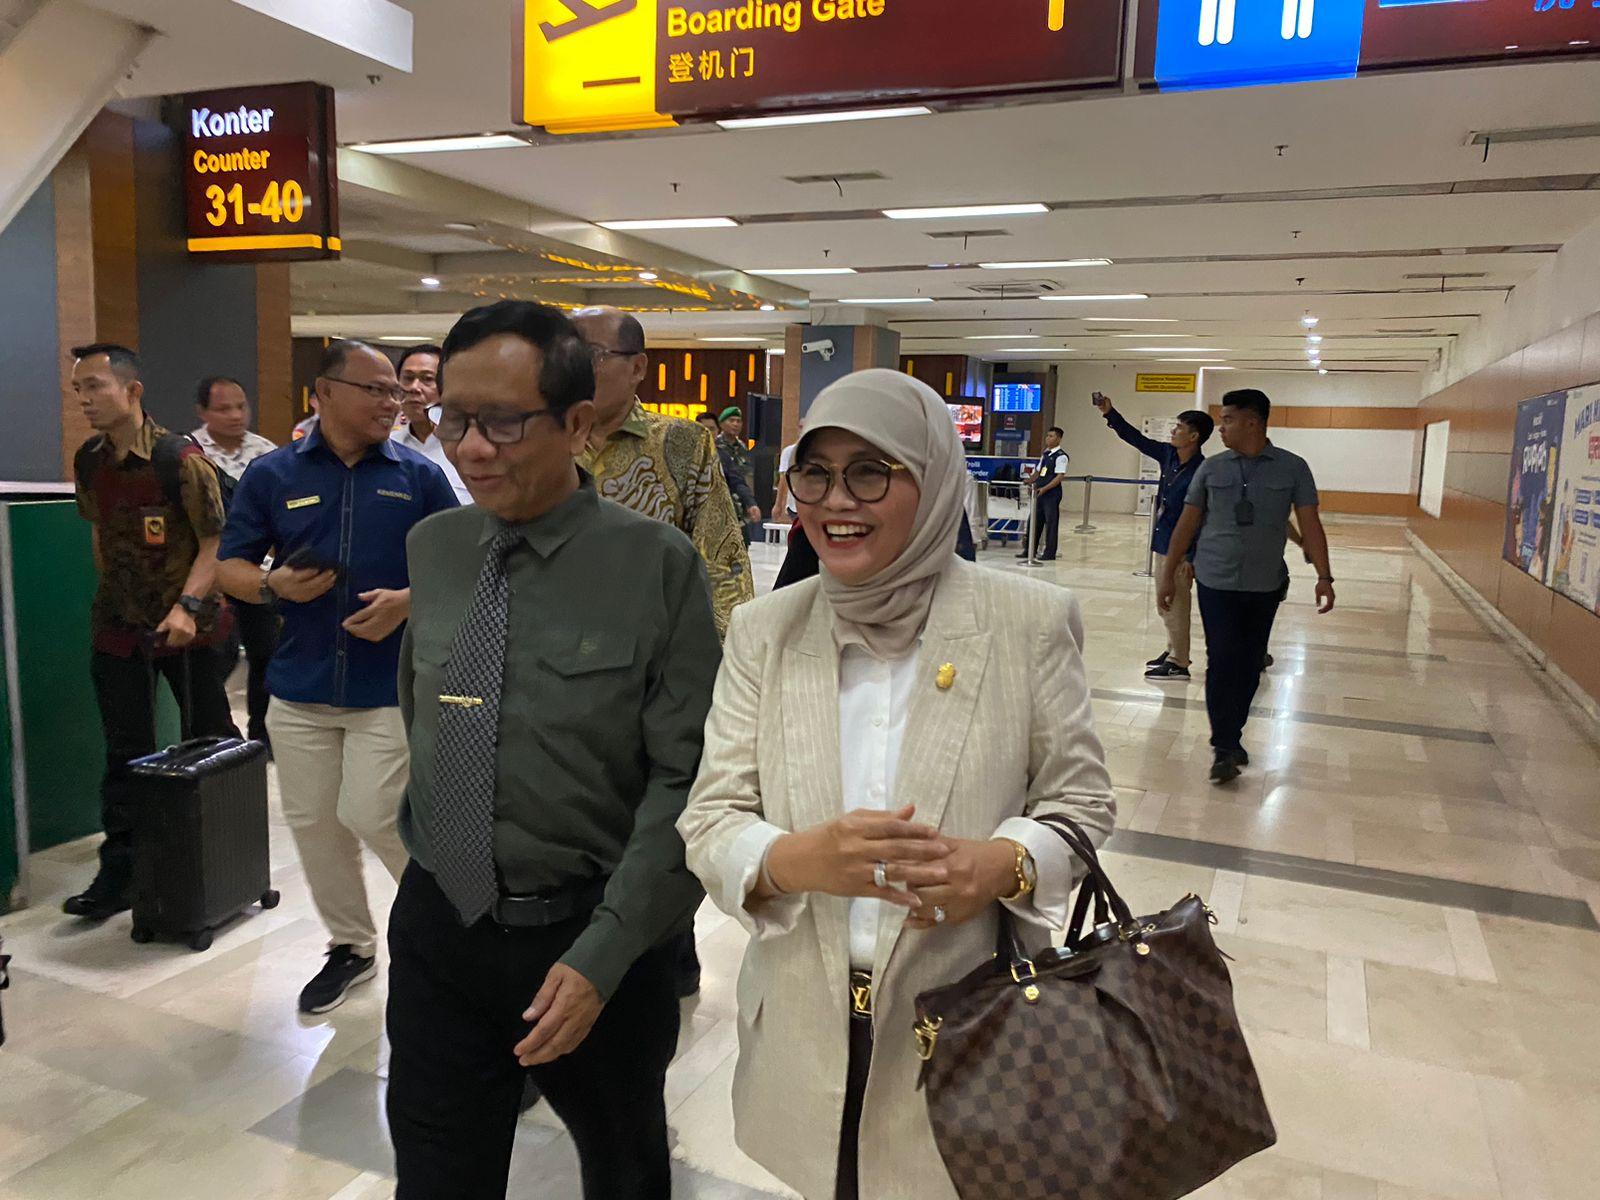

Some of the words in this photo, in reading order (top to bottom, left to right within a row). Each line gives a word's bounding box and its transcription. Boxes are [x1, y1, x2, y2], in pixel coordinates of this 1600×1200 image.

[667, 0, 802, 37] Boarding
[811, 0, 886, 22] Gate
[668, 46, 755, 83] 登机门
[192, 105, 274, 138] Konter
[193, 147, 271, 174] Counter
[206, 179, 304, 227] 31-40
